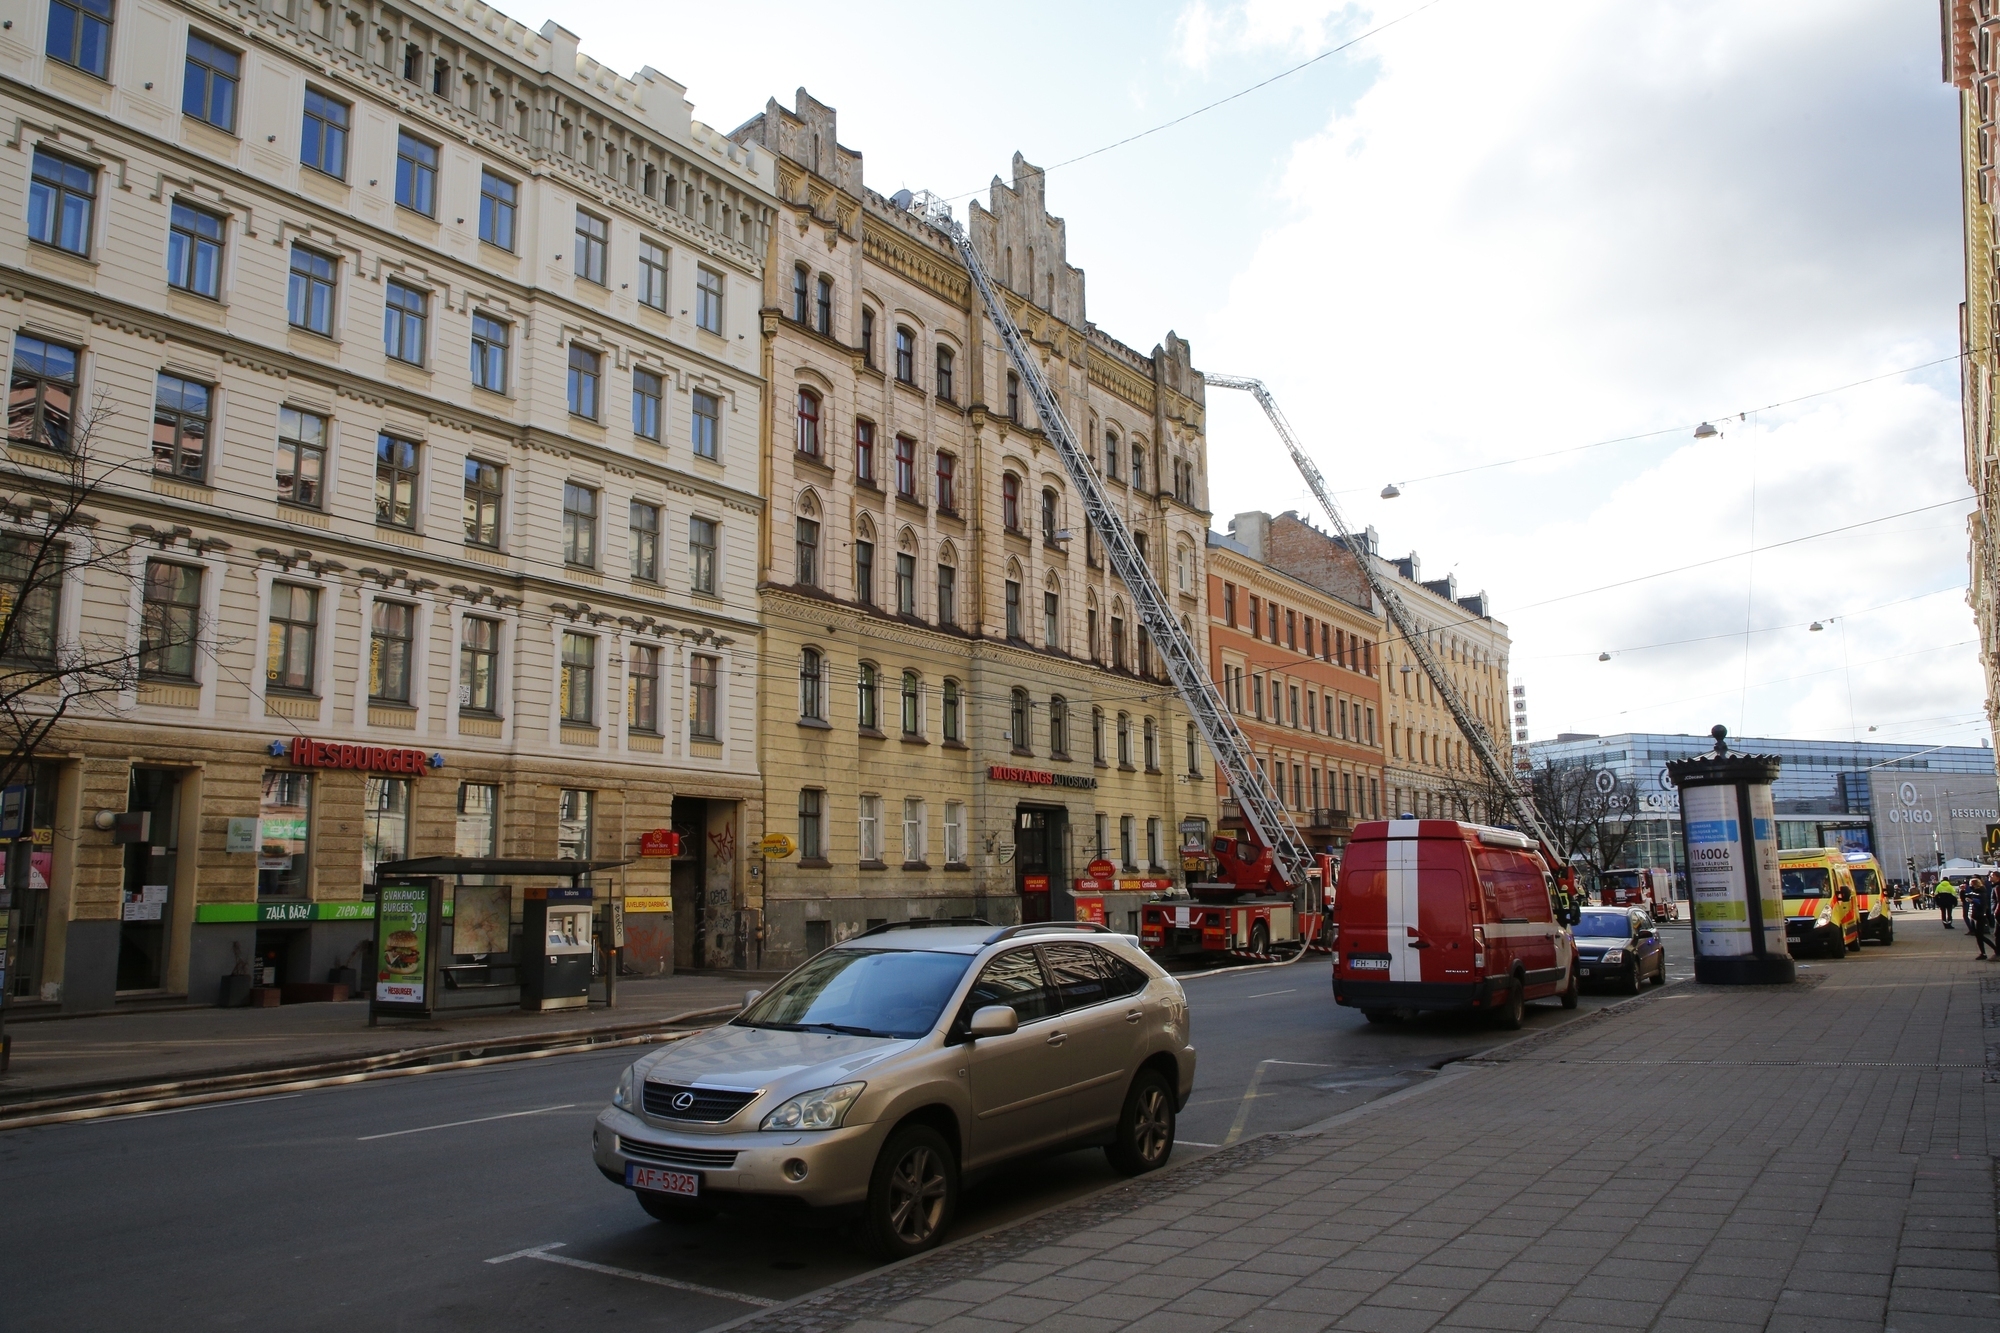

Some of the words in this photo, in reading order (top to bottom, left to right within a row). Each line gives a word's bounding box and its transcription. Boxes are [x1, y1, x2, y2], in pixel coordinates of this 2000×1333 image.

[1514, 688, 1526, 753] HOTEL
[291, 736, 428, 776] HESBURGER
[992, 765, 1053, 785] MUSTANGS
[1053, 773, 1098, 789] AUTOSKOLA
[1219, 759, 1236, 785] MAGIRUS
[1889, 809, 1933, 823] ORIGO
[1951, 808, 1997, 818] RESERVED
[1121, 881, 1141, 889] LOMBARDS
[383, 890, 426, 901] GVAKAMOLE
[383, 902, 414, 912] BURGERS
[387, 986, 413, 996] HESBURGER
[636, 1168, 695, 1193] AF-5325
